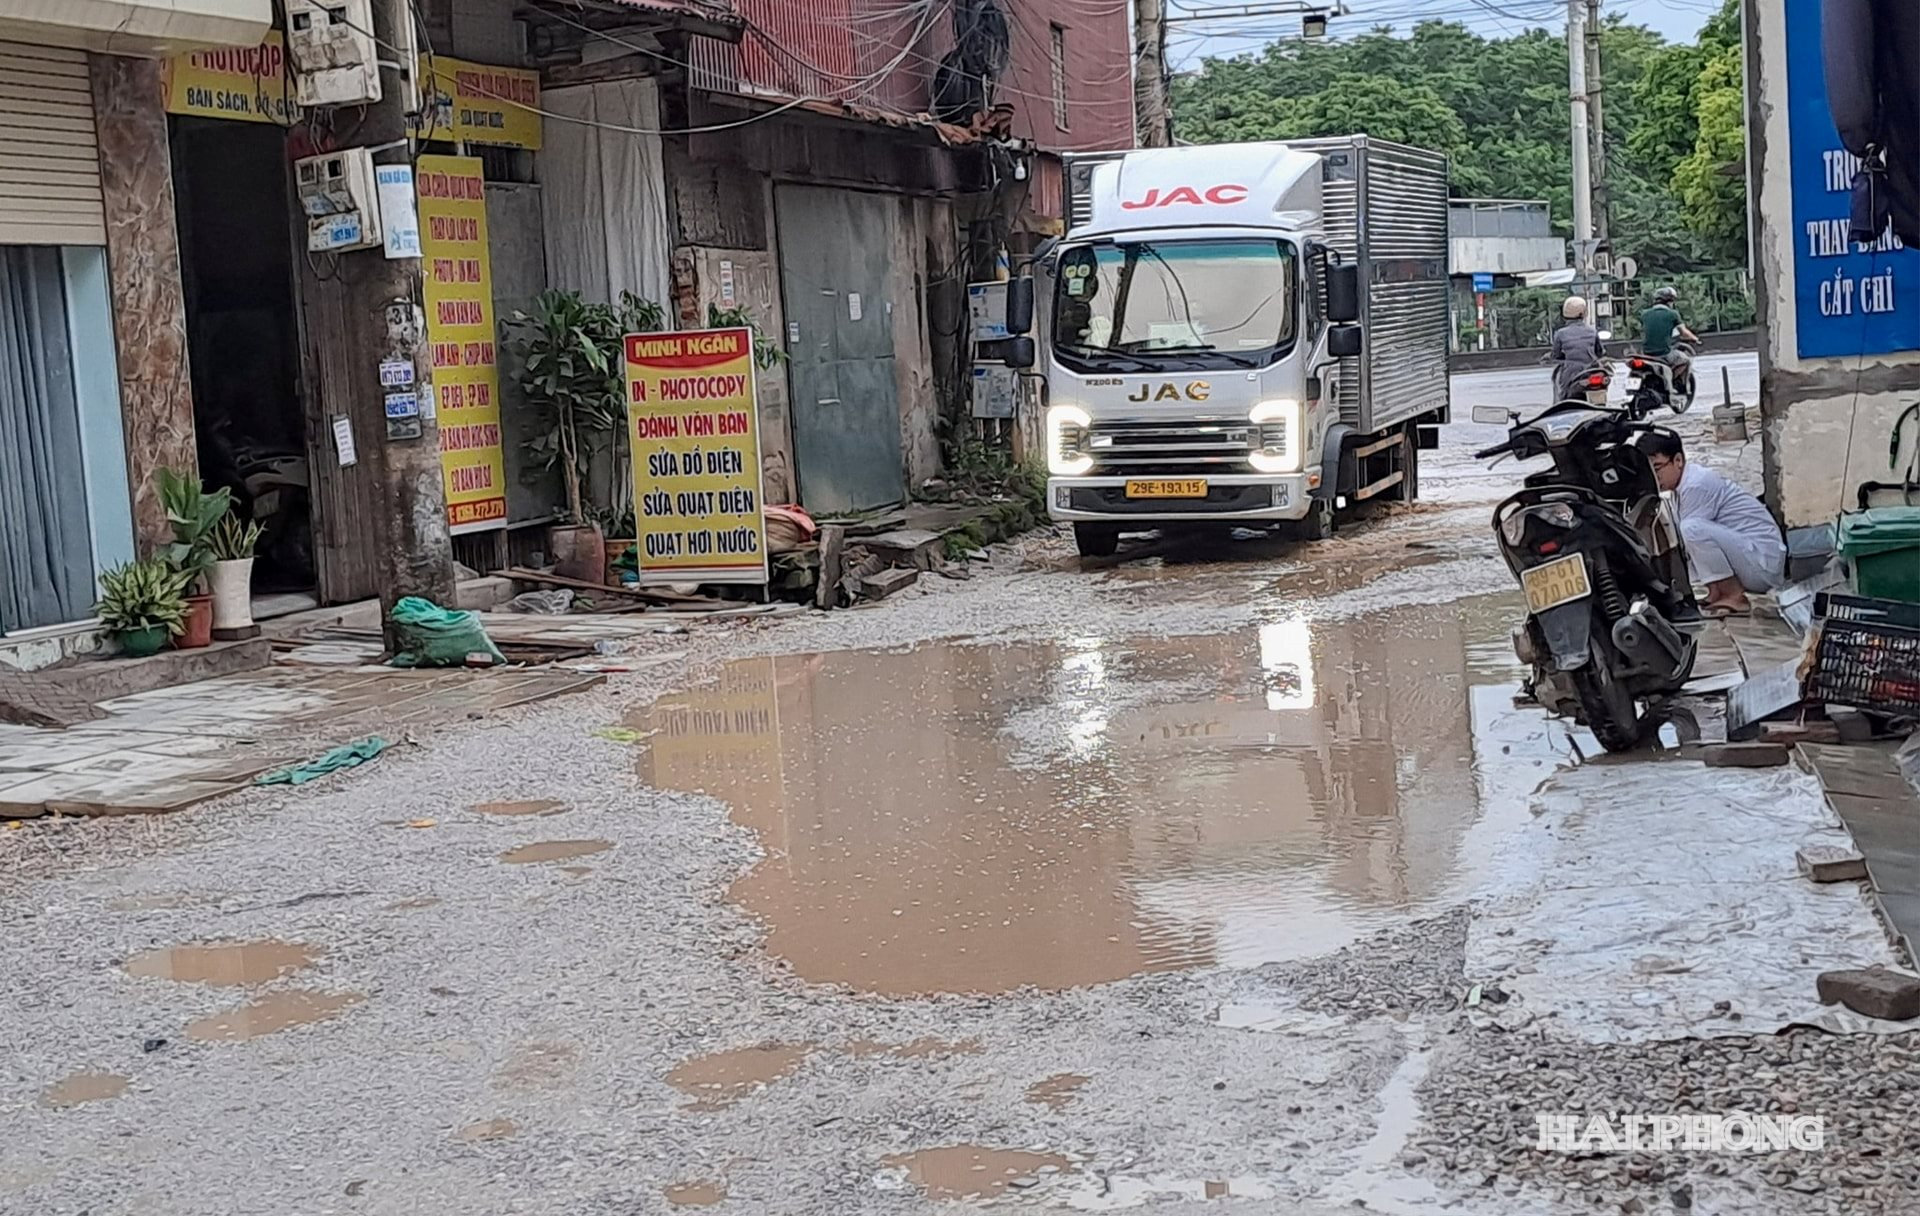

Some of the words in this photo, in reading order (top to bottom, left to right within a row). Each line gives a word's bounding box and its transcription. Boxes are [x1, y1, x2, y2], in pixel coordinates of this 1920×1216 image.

[1121, 184, 1249, 210] JAC
[1806, 219, 1851, 257] THAY
[1820, 267, 1854, 316] CẮT
[1860, 266, 1895, 313] CHỈ
[634, 338, 683, 359] MINH
[686, 333, 739, 356] NGÂN
[631, 379, 647, 402] IN
[659, 374, 747, 401] PHOTOCOPY
[1127, 379, 1211, 403] JAC
[637, 412, 679, 439] ĐÁNH
[682, 410, 714, 436] VĂN
[718, 406, 748, 435] BẢN
[648, 446, 679, 477] SỬA
[682, 444, 704, 475] ĐỒ
[707, 446, 743, 479] ĐIỆN
[643, 486, 674, 516] SỬA
[677, 491, 714, 520] QUẠT
[719, 485, 755, 519] ĐIỆN
[645, 532, 683, 560] QUẠT
[687, 529, 713, 555] HƠI
[716, 525, 758, 554] NƯỚC
